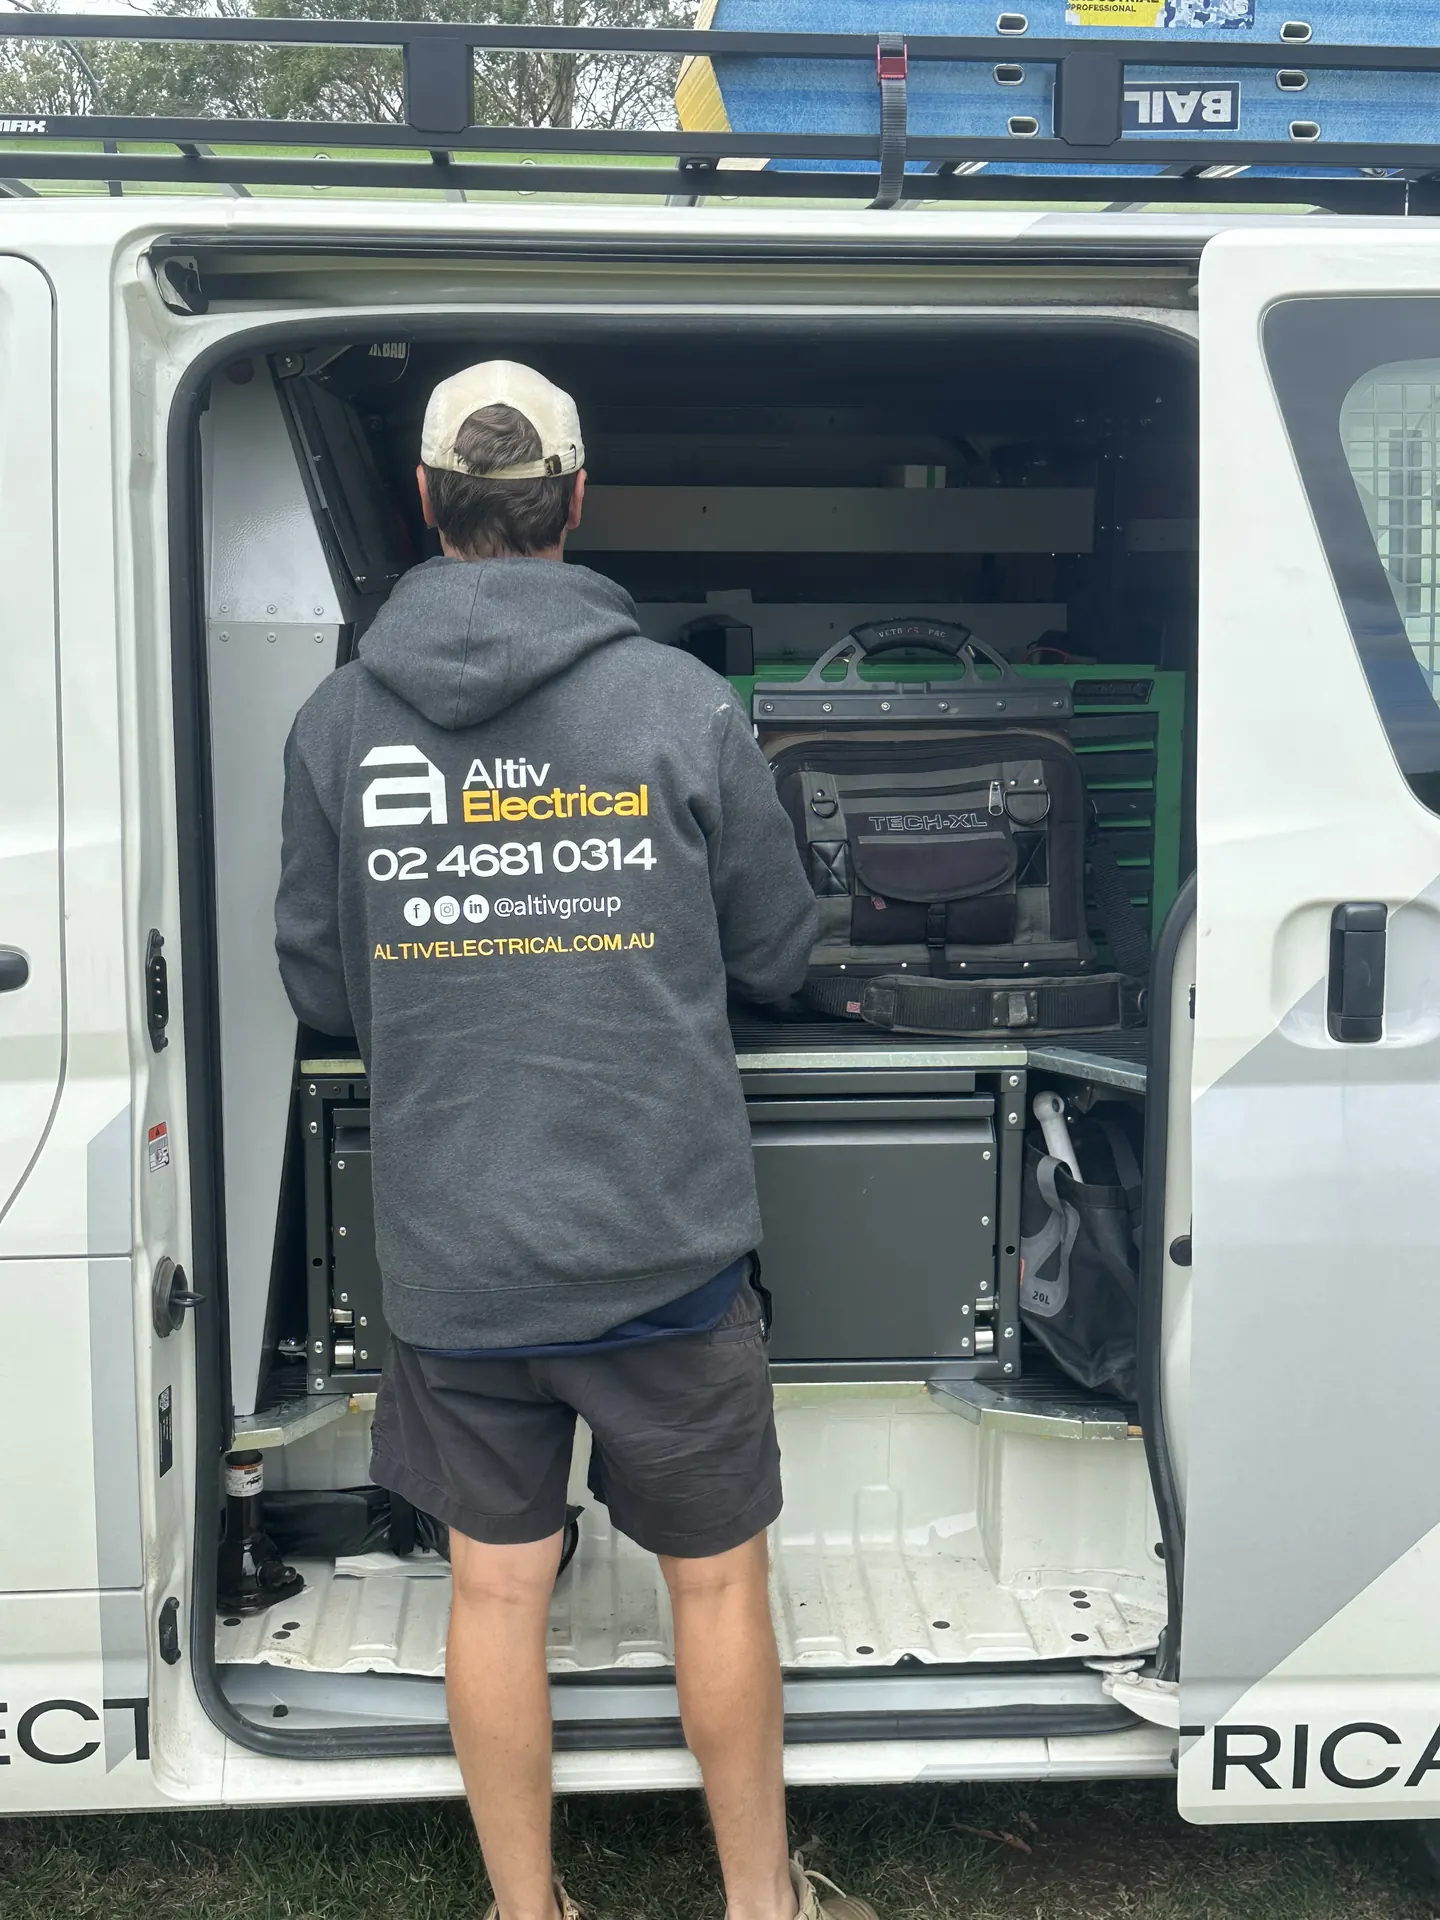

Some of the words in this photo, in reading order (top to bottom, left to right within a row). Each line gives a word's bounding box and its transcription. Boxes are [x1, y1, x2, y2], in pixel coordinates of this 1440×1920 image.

[1070, 4, 1136, 12] PROFESSIONAL
[1123, 90, 1231, 123] BAIL
[462, 757, 550, 789] Altiv
[463, 784, 648, 822] Electrical
[868, 813, 988, 831] TECH-XL
[367, 847, 429, 881] 02
[436, 841, 544, 878] 4681
[553, 837, 657, 873] 0314
[494, 895, 621, 919] @altivgroup
[374, 932, 655, 960] ALTIVELECTRICAL.COM.AU
[1032, 1290, 1050, 1305] 20L
[0, 1698, 150, 1765] CT
[1179, 1721, 1440, 1791] RIC
